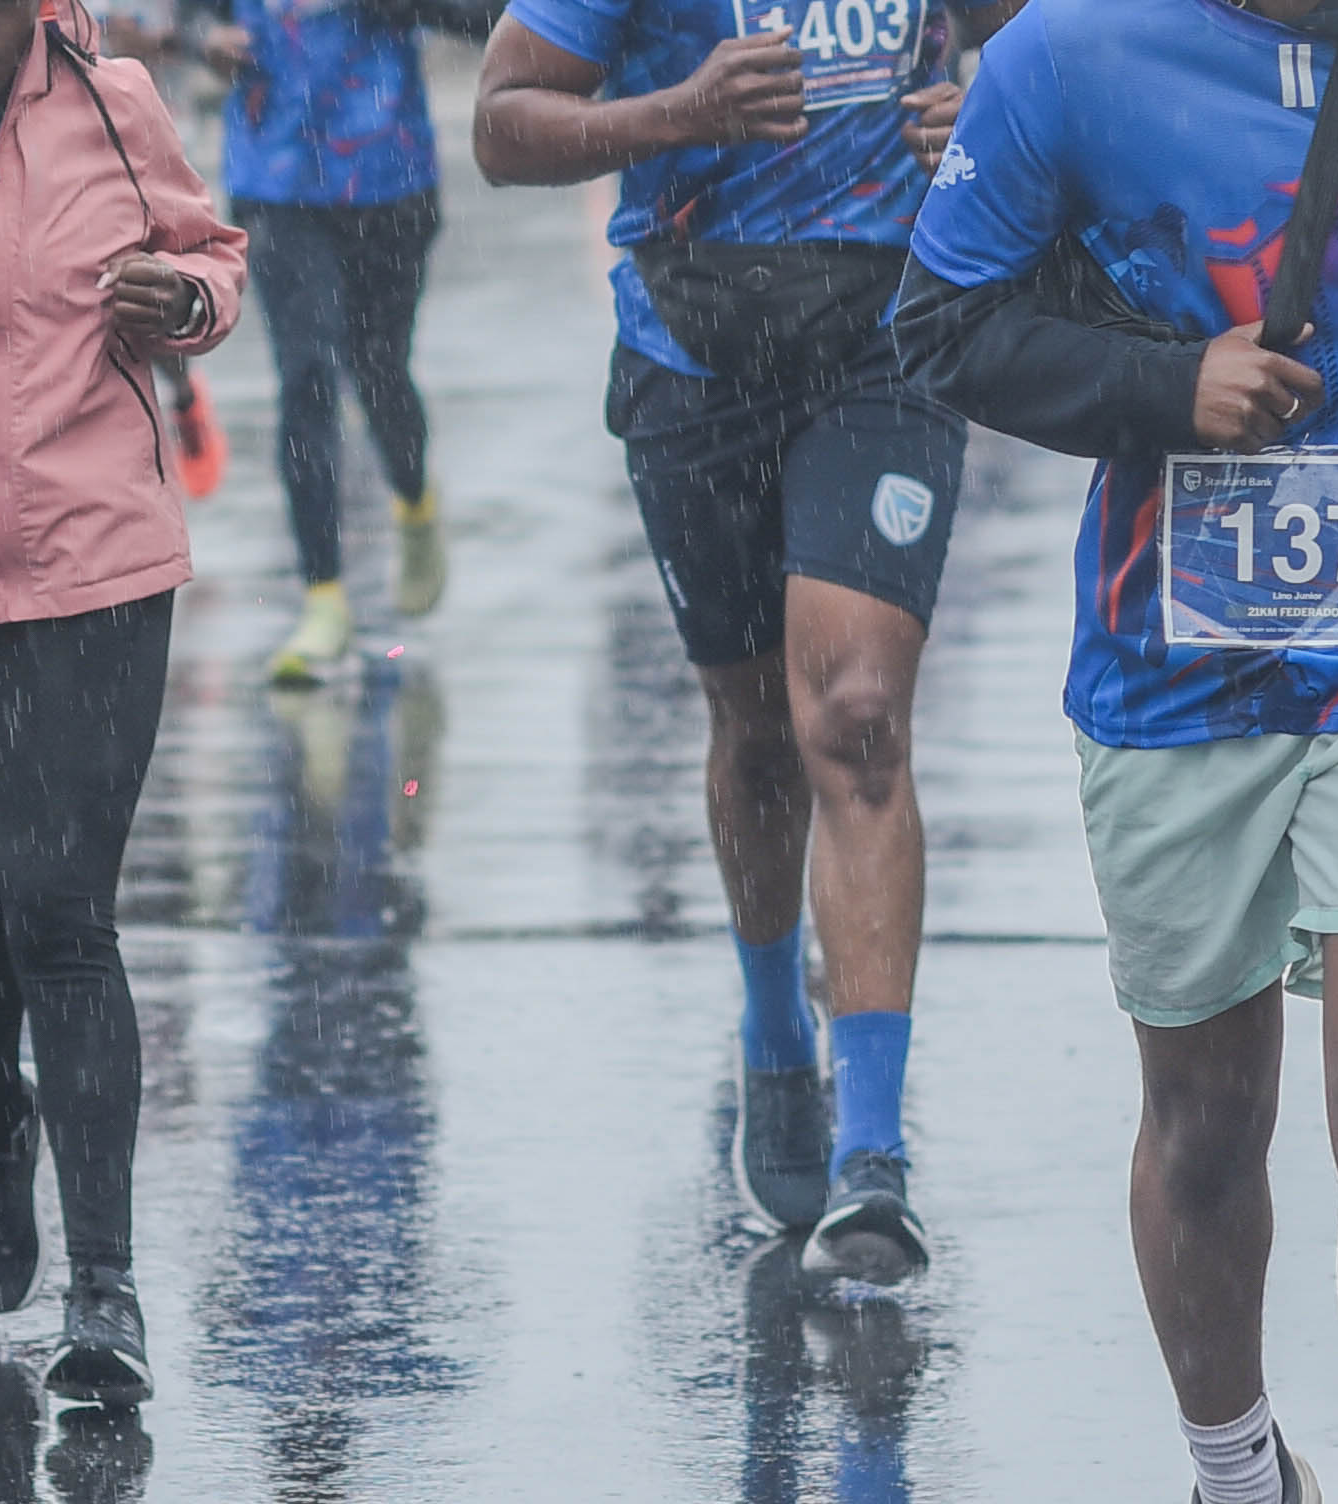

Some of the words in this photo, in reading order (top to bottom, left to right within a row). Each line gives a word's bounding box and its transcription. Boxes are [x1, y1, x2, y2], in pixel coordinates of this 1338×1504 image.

[1248, 475, 1274, 488] Bank
[1272, 591, 1292, 601] Lino
[1293, 591, 1324, 601] Junior
[1247, 606, 1278, 618] 21KM
